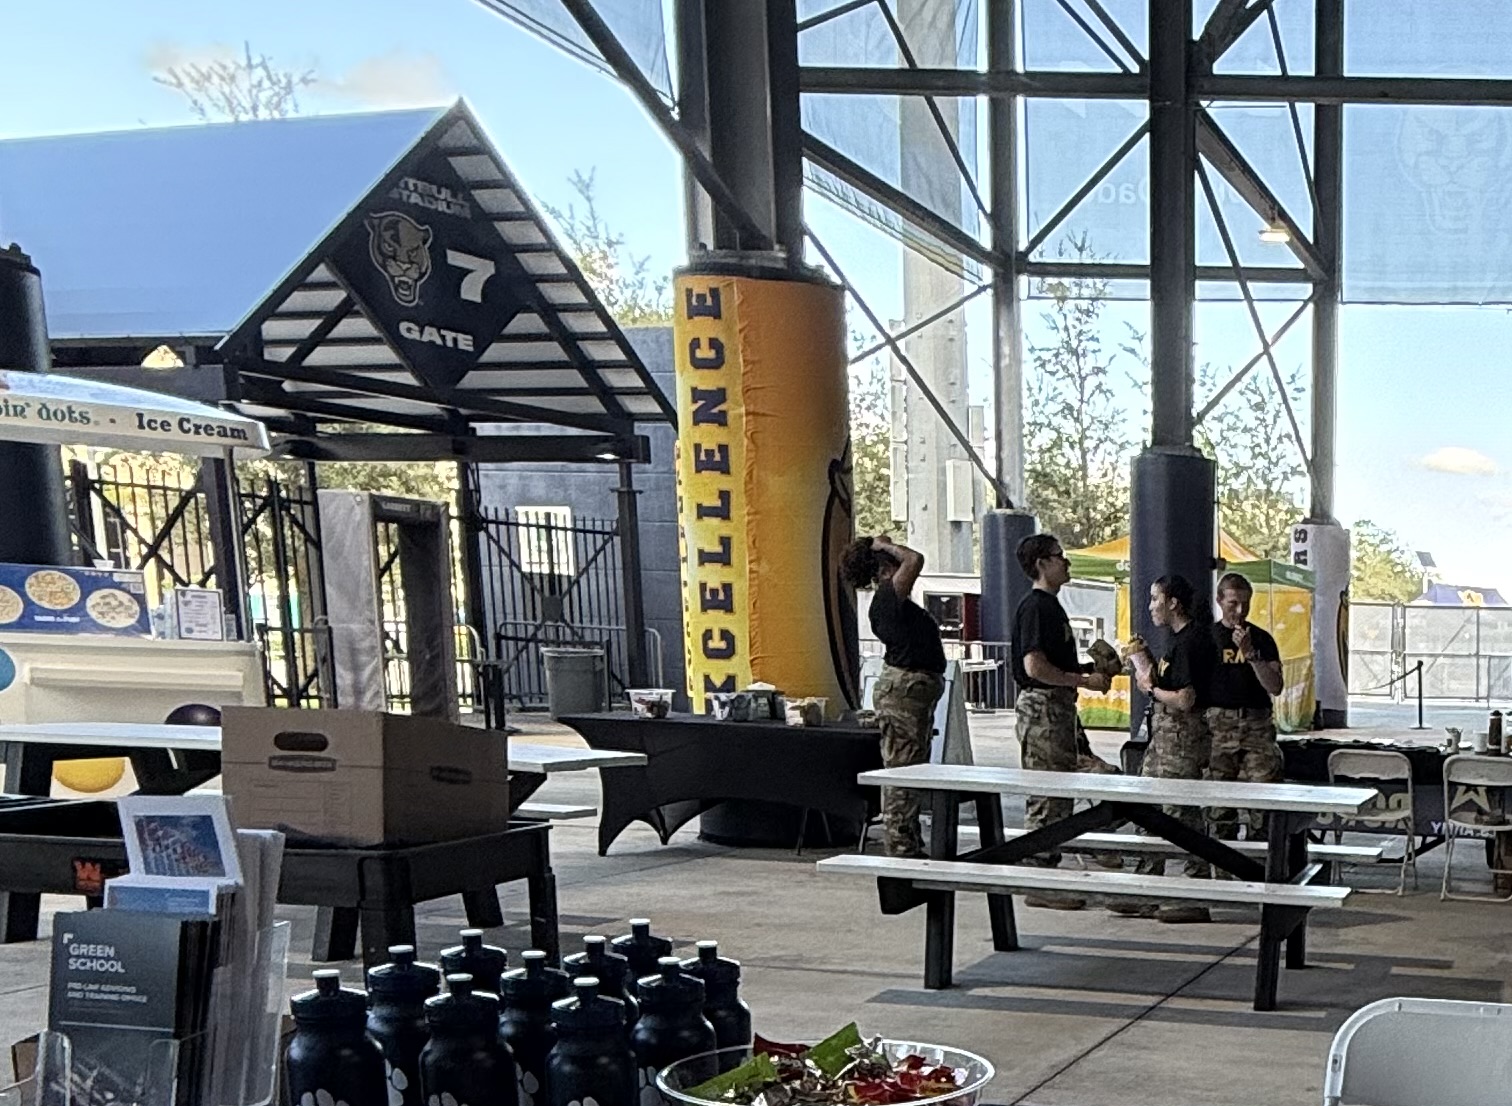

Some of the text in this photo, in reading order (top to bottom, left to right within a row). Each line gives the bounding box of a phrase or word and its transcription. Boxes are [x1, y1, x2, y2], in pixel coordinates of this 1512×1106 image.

[446, 248, 496, 304] 7
[399, 321, 475, 352] GATE
[135, 412, 249, 441] Ice Cream
[69, 943, 115, 957] GREEN
[68, 957, 125, 973] SCHOOL
